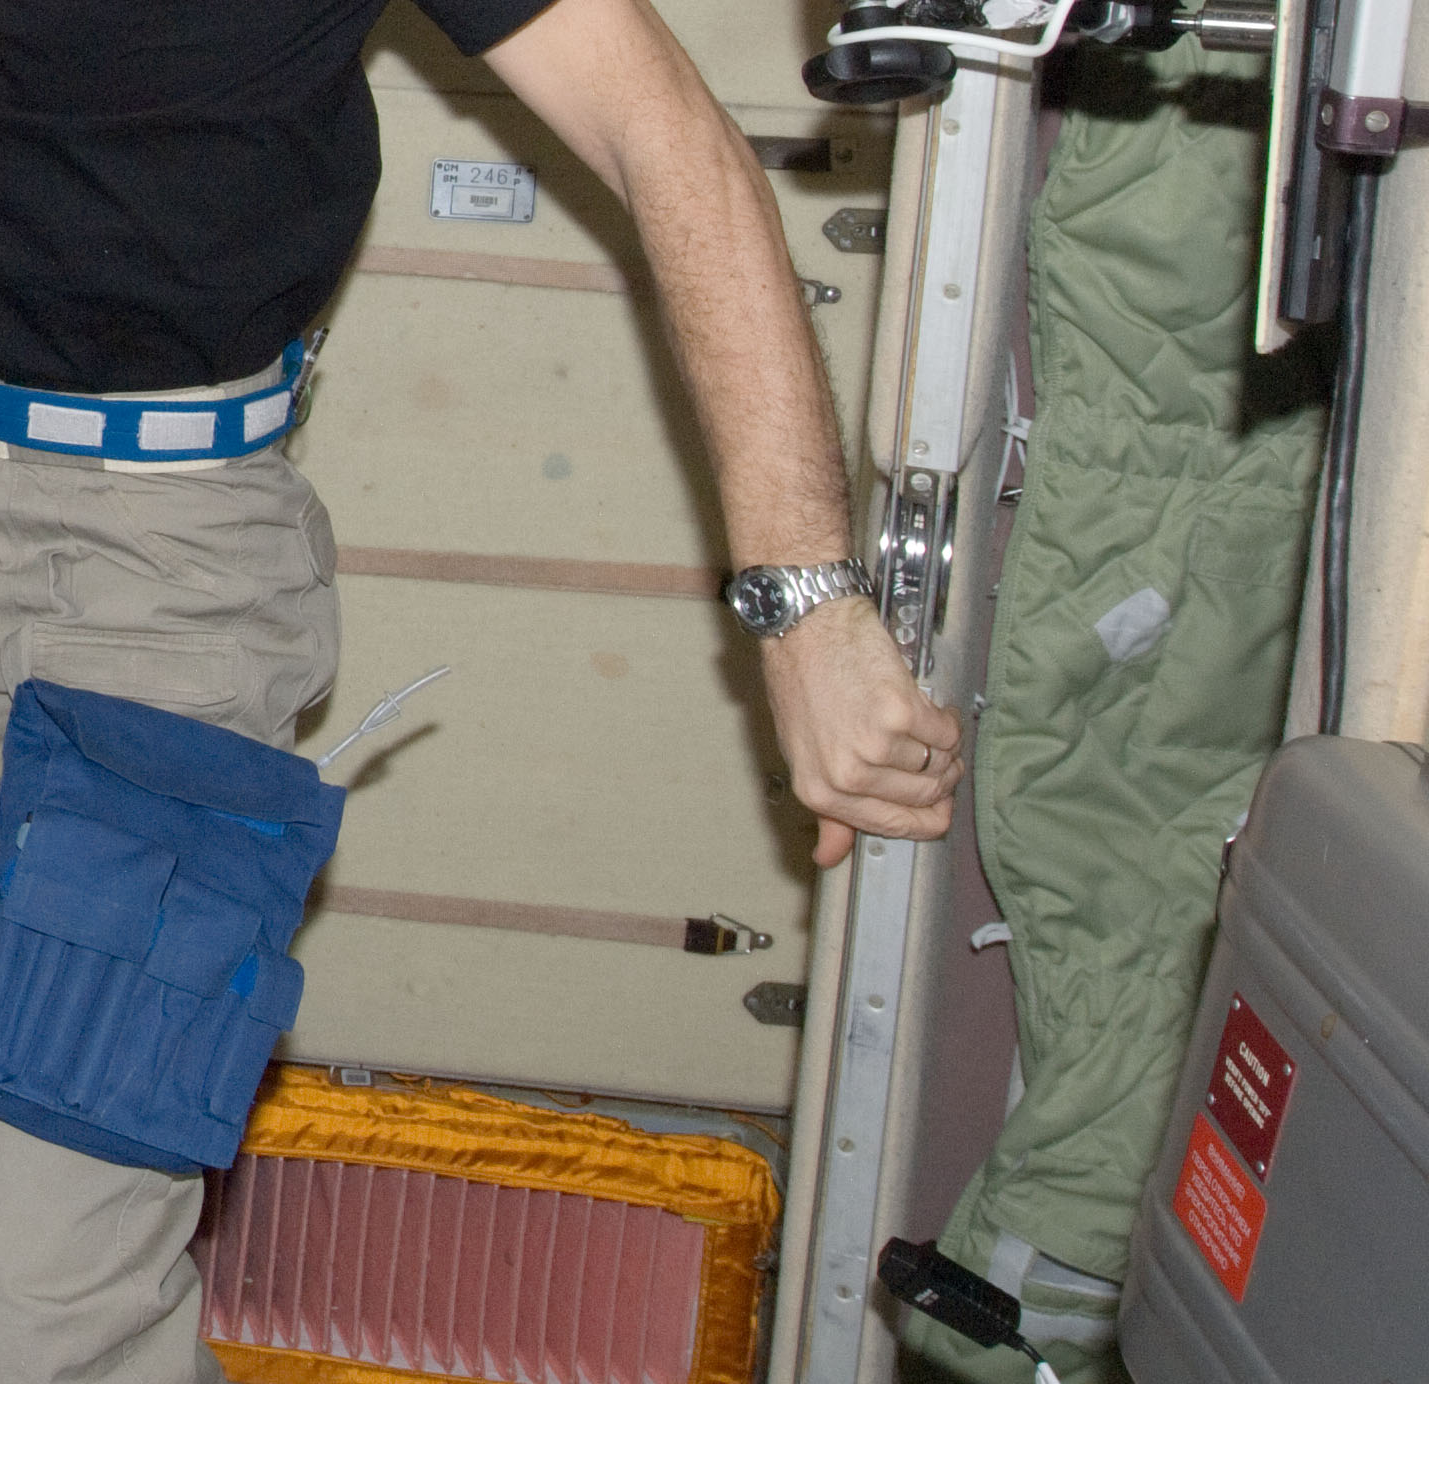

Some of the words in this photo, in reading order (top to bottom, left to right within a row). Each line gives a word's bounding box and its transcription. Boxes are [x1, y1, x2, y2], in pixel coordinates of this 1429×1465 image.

[470, 167, 508, 185] 246
[1239, 1041, 1271, 1088] CAUTION
[1242, 1096, 1265, 1130] OPENING
